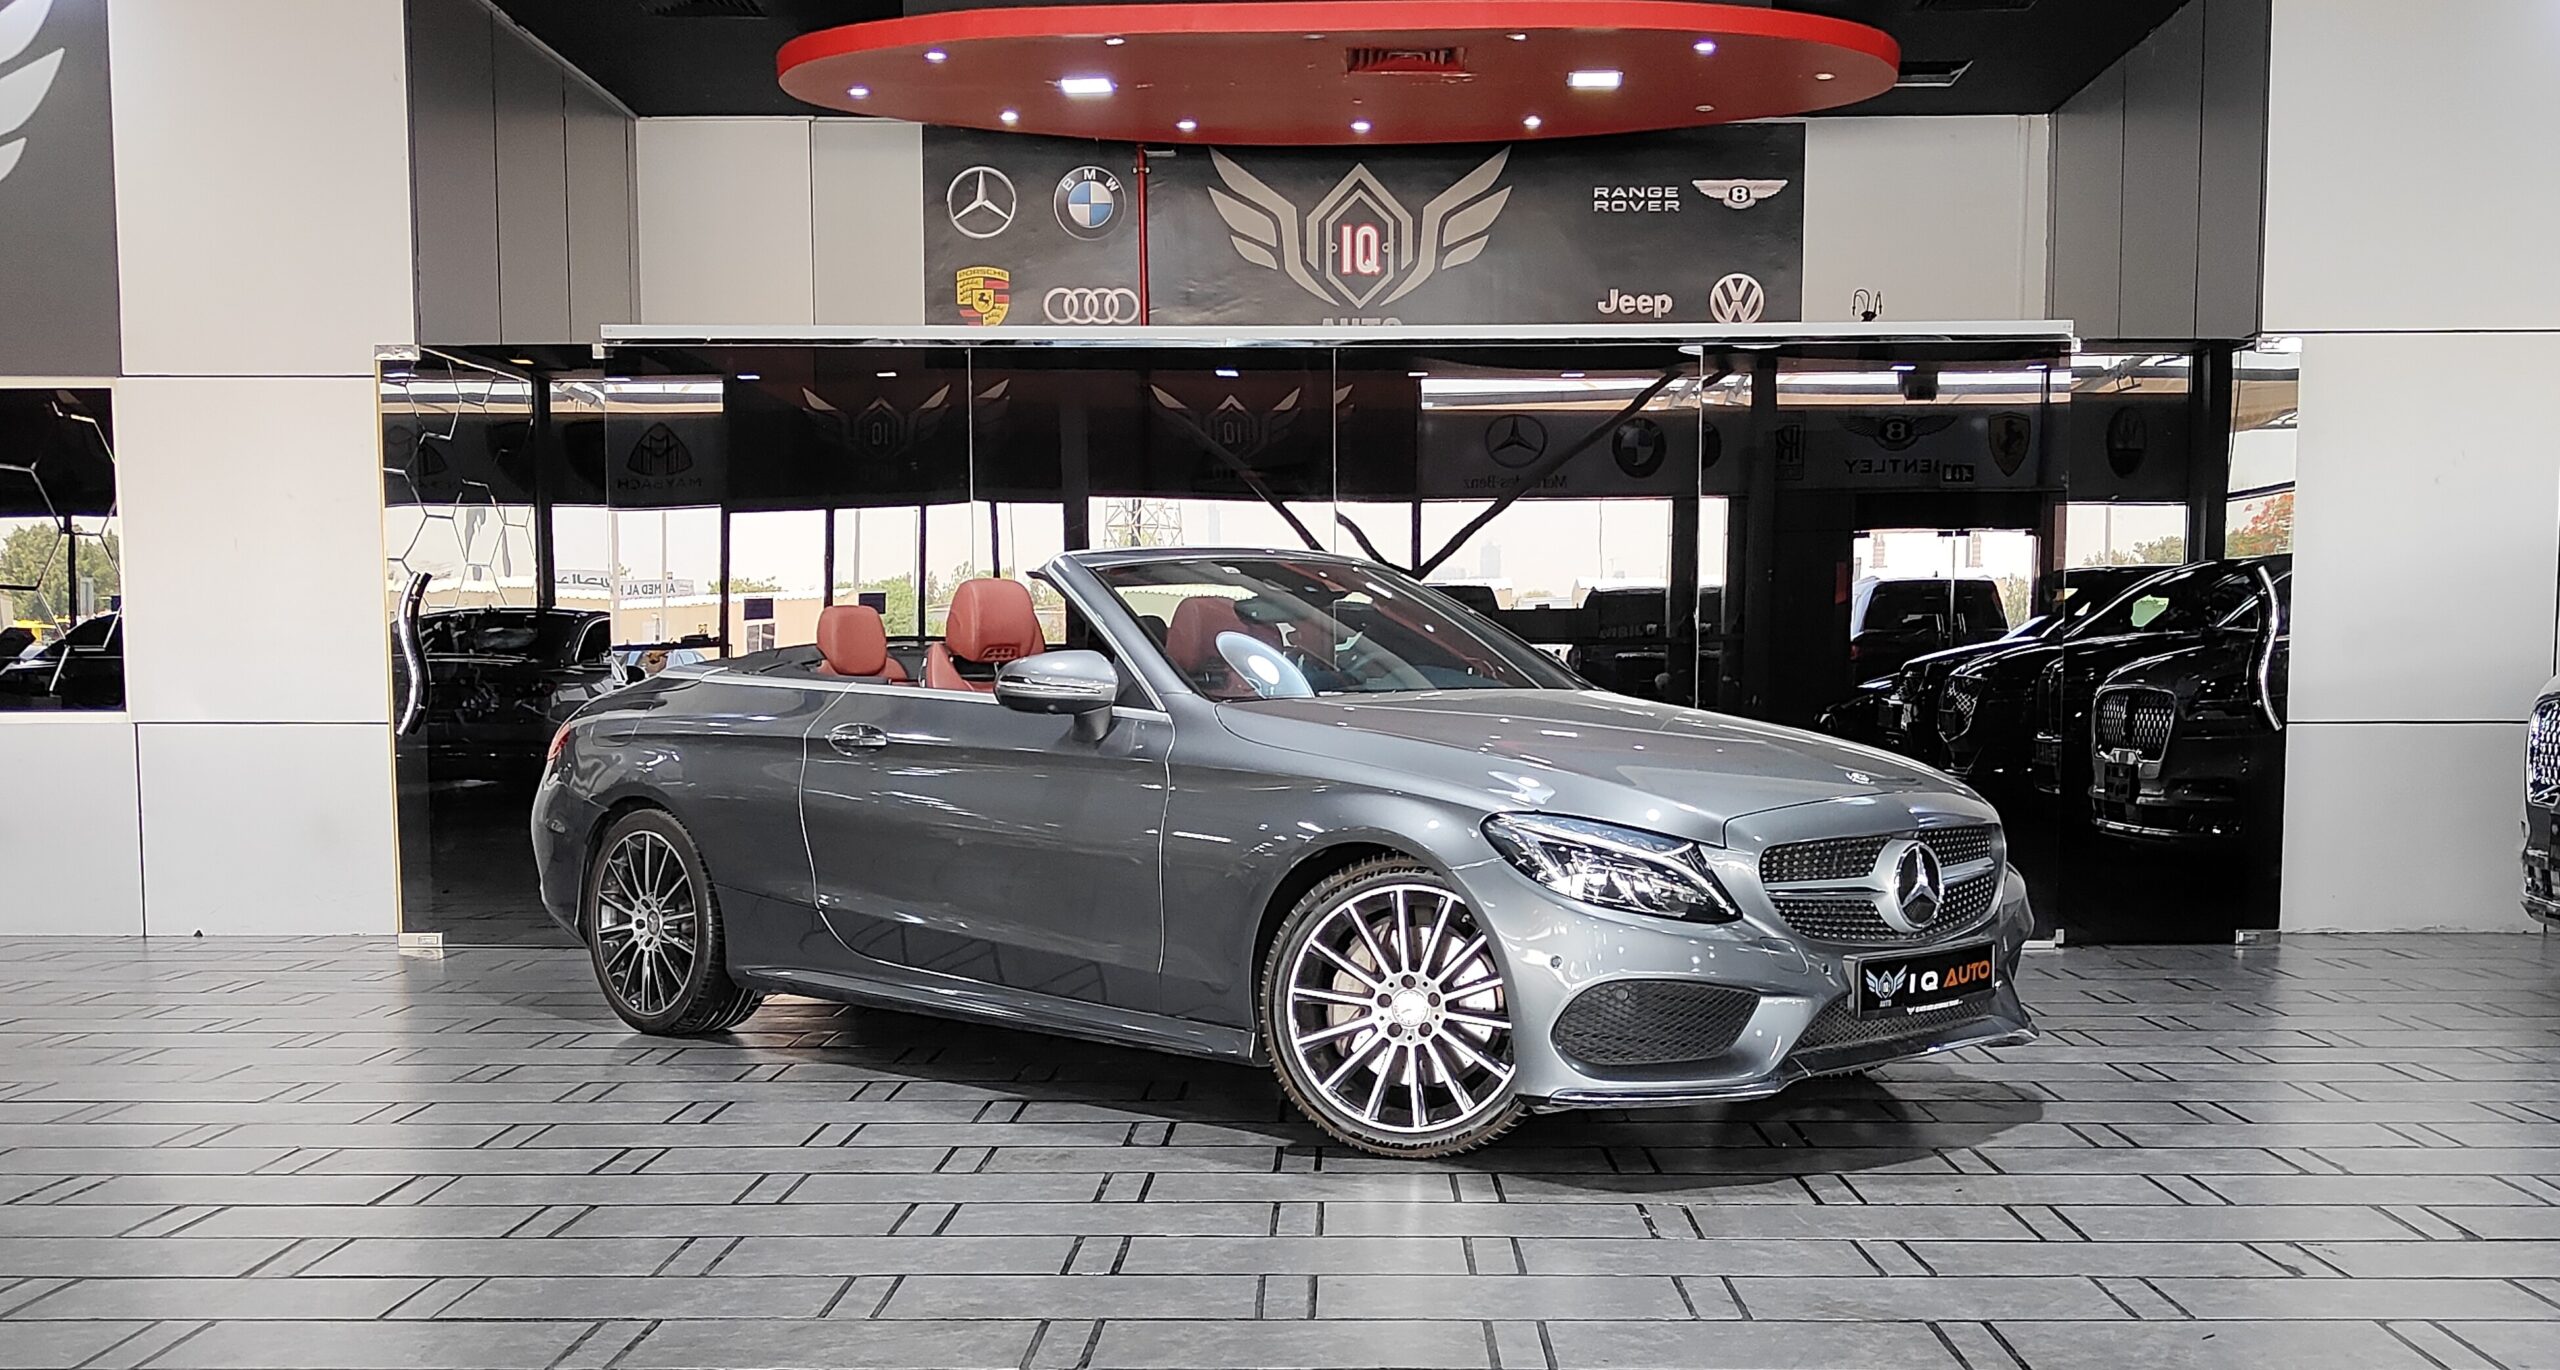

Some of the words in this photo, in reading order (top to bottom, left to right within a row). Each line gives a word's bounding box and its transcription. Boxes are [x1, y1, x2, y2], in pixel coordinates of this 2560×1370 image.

[1062, 168, 1120, 193] BMW
[1593, 186, 1679, 198] RANGE
[1593, 200, 1681, 212] ROVER
[1341, 225, 1380, 275] IQ
[958, 268, 1008, 279] PORSCHE
[1597, 288, 1673, 318] Jeep
[1943, 960, 1990, 988] AUTO
